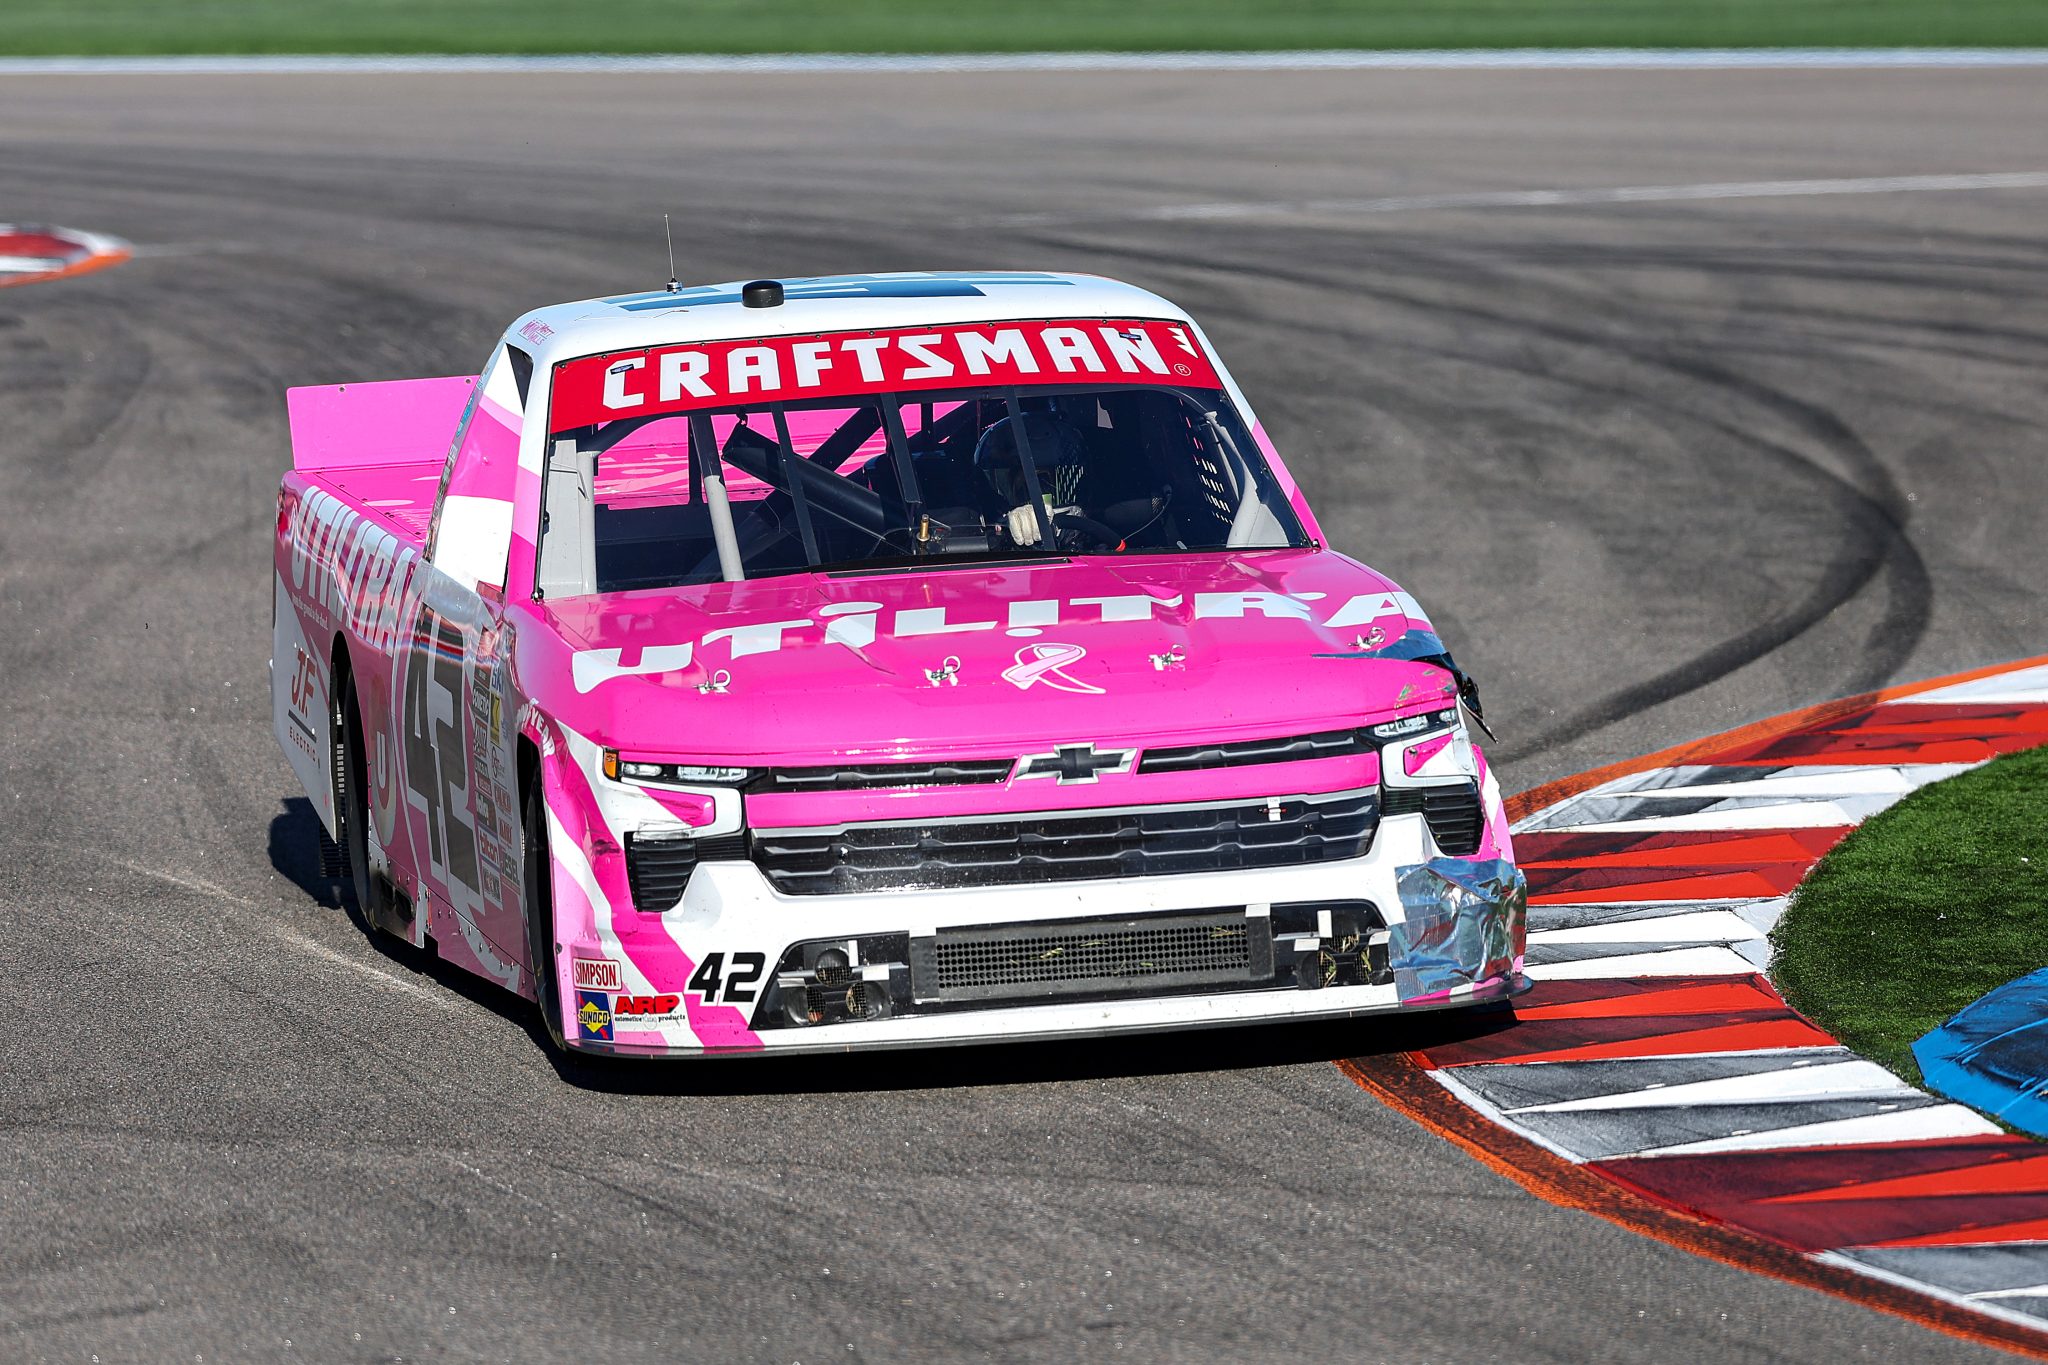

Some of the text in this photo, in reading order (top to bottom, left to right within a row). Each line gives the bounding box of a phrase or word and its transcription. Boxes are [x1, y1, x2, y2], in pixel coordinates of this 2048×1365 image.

[602, 326, 1171, 410] CRAFTSMAN
[403, 603, 482, 898] 42
[574, 960, 618, 987] SIMPSON
[687, 951, 767, 1003] 42
[579, 1008, 608, 1024] SUNOCO
[614, 994, 681, 1015] ARP
[658, 1013, 686, 1024] products
